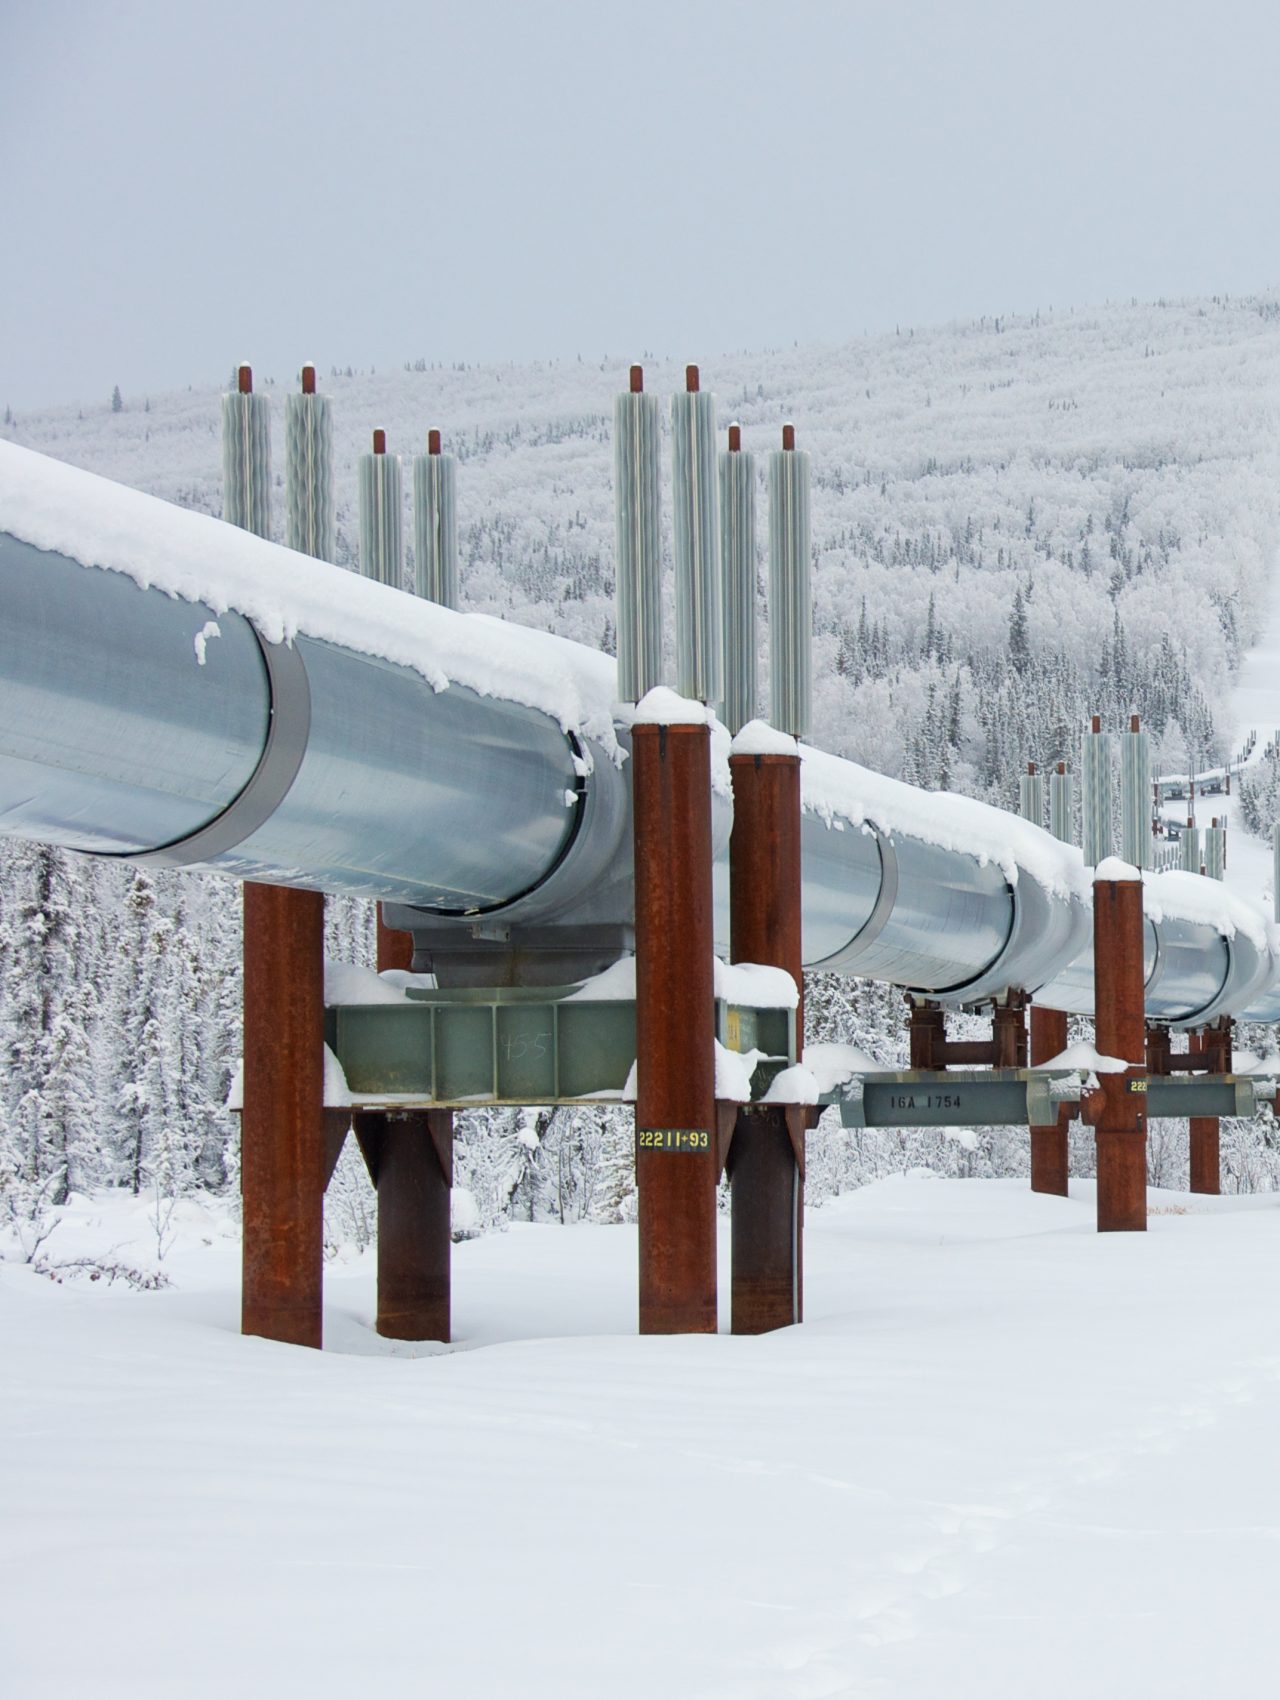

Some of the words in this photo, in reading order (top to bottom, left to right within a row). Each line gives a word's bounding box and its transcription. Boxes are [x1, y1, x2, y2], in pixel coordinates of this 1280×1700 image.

[891, 1095, 915, 1109] 16A
[927, 1095, 961, 1109] 1754
[639, 1131, 708, 1147] 22211+93
